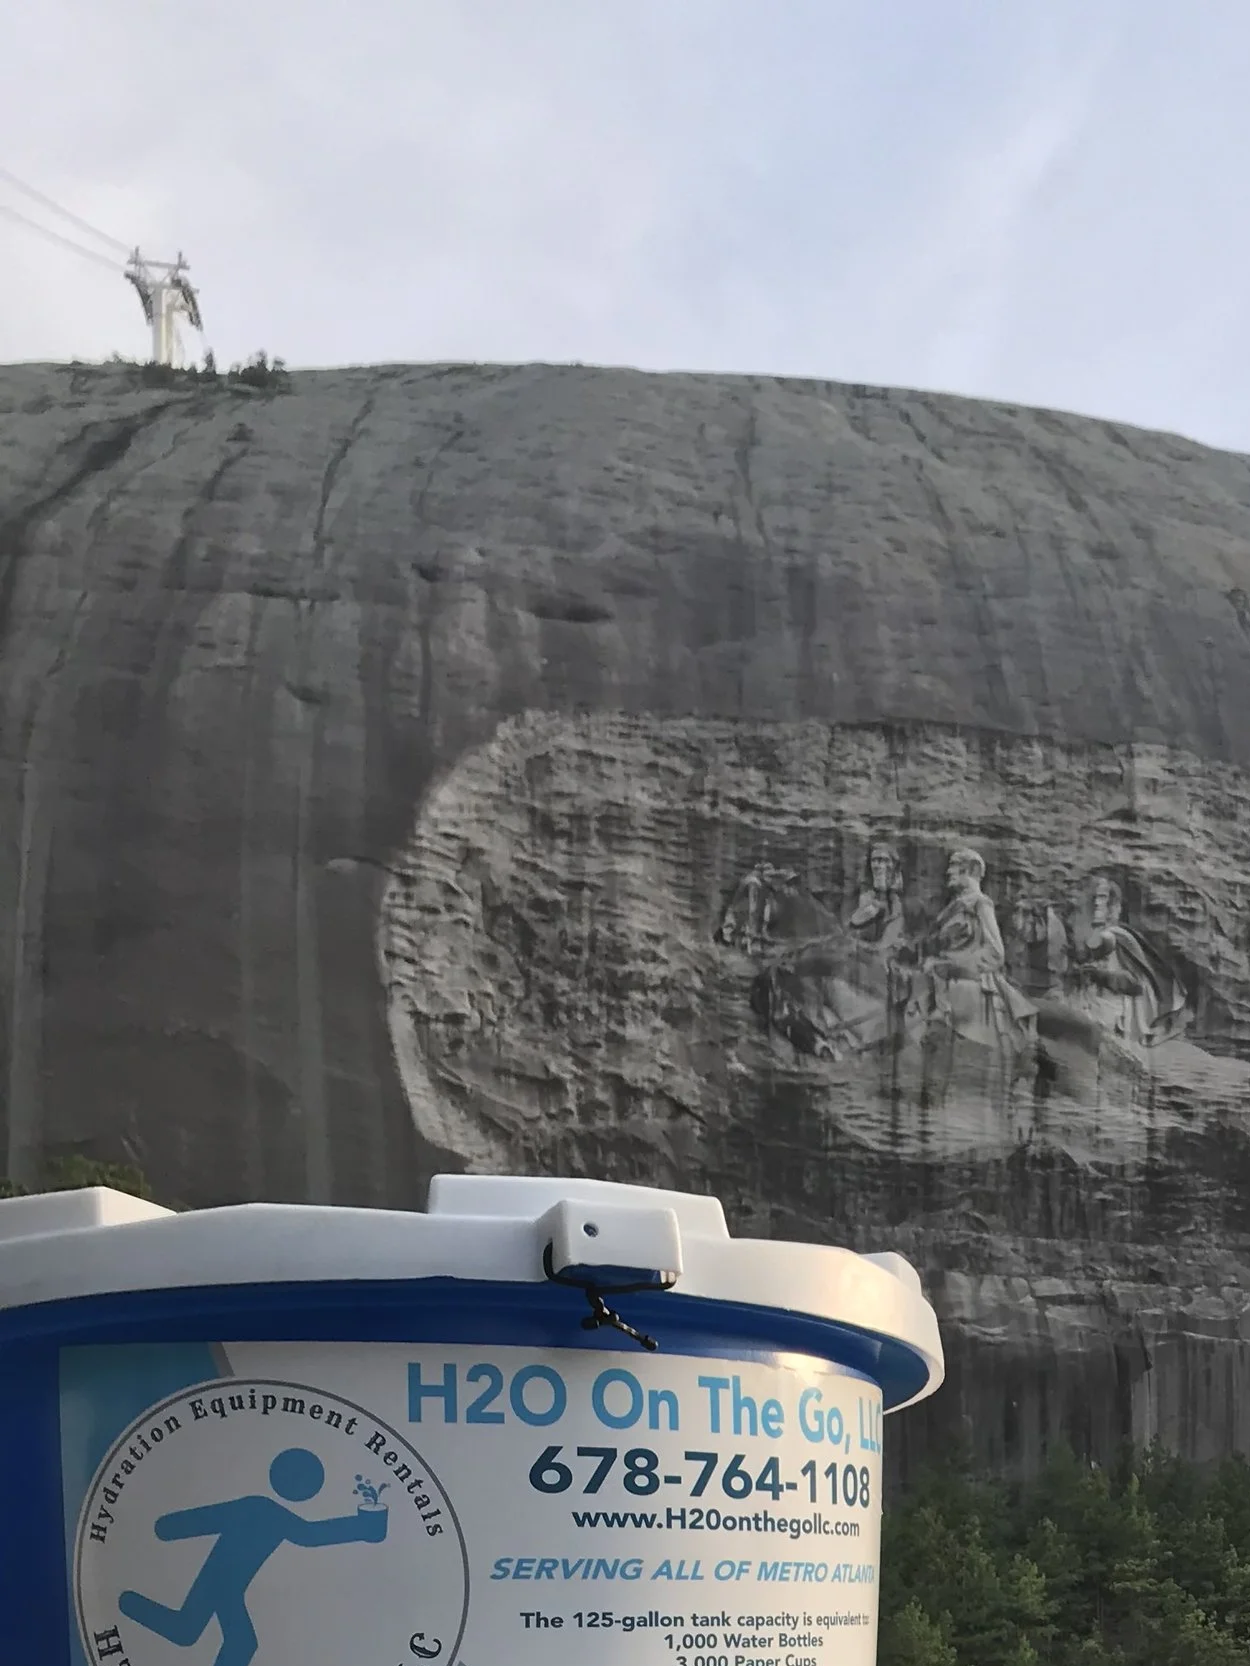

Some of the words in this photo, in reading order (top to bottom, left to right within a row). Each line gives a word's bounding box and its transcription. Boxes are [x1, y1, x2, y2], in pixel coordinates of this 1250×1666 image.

[408, 1362, 567, 1427] H2O
[592, 1368, 680, 1431] On
[698, 1376, 784, 1439] The
[798, 1387, 851, 1455] Go,
[90, 1415, 181, 1544] Hydration
[189, 1388, 359, 1436] Equipment
[365, 1431, 443, 1537] Rentals
[528, 1445, 870, 1508] 678-764-1108
[489, 1557, 644, 1581] SERVING
[651, 1559, 705, 1581] ALL
[714, 1560, 752, 1581] OF
[757, 1561, 829, 1583] METRO
[520, 1611, 564, 1628] The
[573, 1611, 685, 1632] 125-gallon
[691, 1611, 731, 1627] tank
[737, 1611, 799, 1631] capacity
[803, 1612, 813, 1627] is
[816, 1610, 861, 1630] equivalent
[664, 1633, 718, 1652] 1,000
[723, 1633, 774, 1649] Water
[779, 1631, 824, 1648] Bottles
